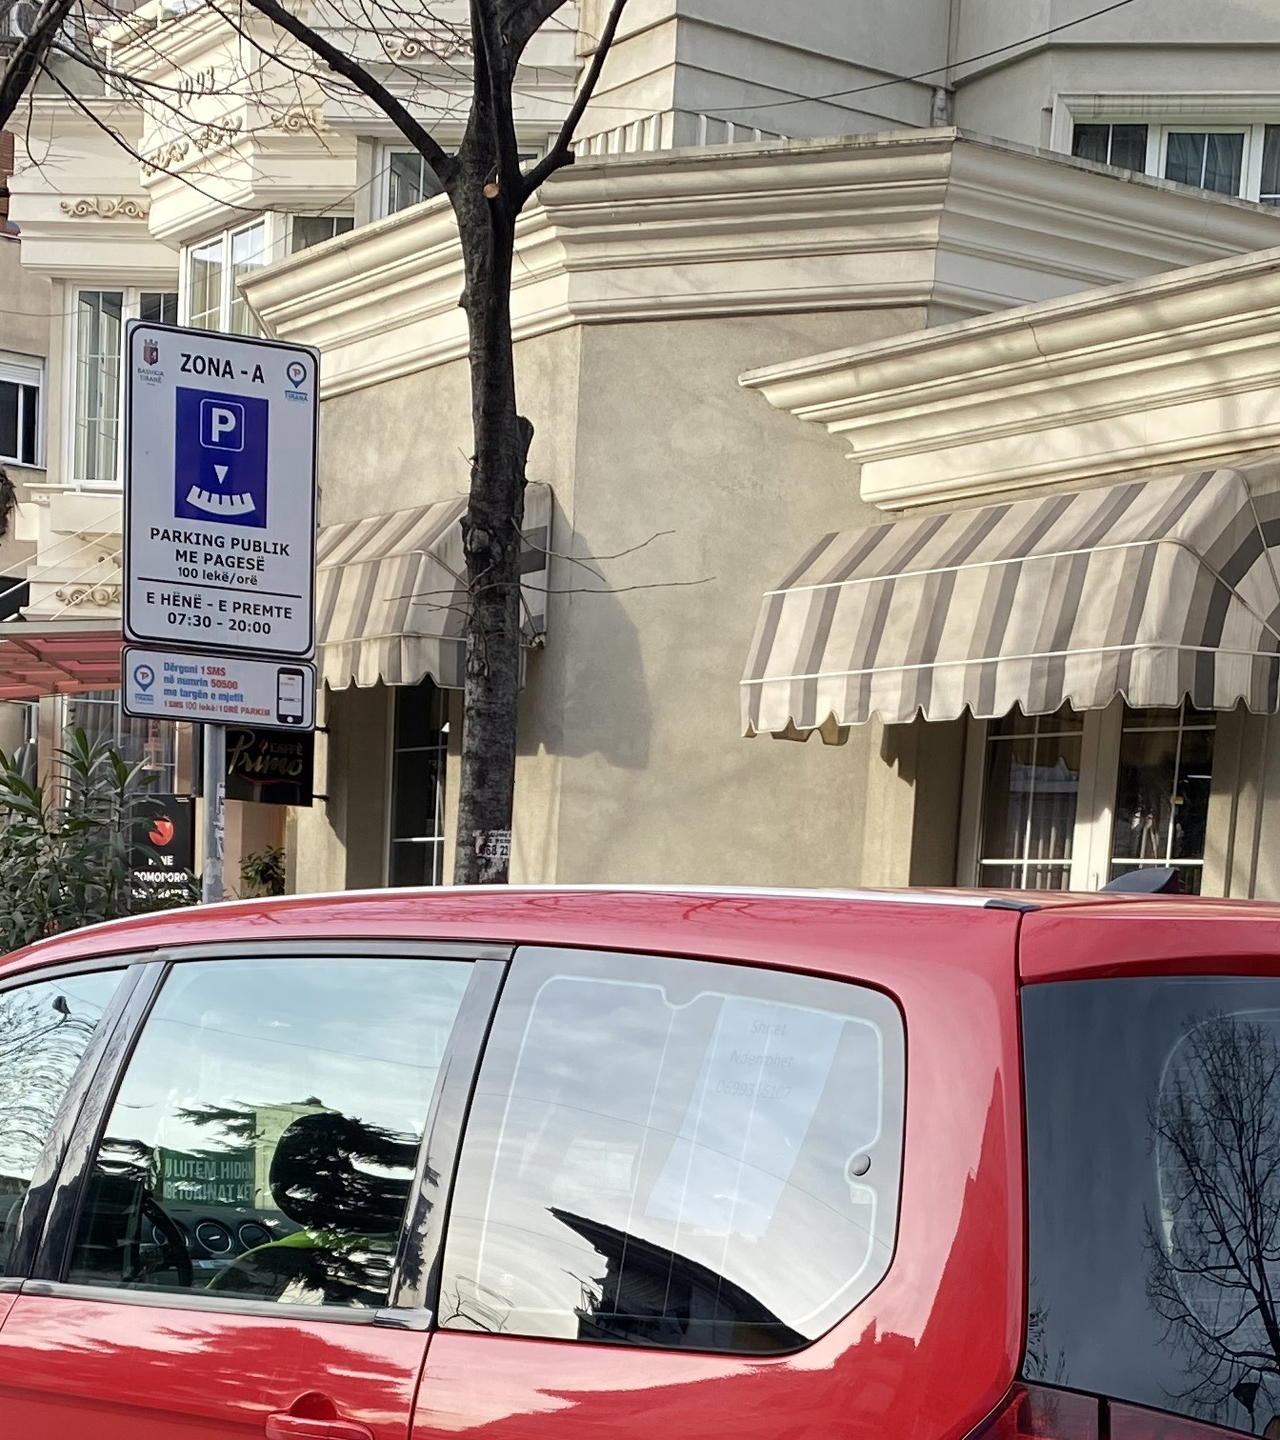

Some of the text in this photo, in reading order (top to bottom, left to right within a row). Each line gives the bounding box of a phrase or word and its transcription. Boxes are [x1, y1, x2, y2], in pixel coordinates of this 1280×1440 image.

[180, 352, 235, 380] ZONA
[251, 363, 265, 383] A
[211, 407, 236, 443] P
[150, 527, 290, 556] PARKING PUBLIK
[175, 549, 265, 572] ME PAGESË
[178, 566, 198, 578] 100
[146, 592, 155, 604] E
[161, 591, 202, 609] HËNË
[218, 600, 227, 612] E
[233, 601, 293, 619] PREMTE
[167, 612, 212, 628] 07:30
[228, 618, 272, 635] 20:00
[163, 662, 198, 675] Dërgoni
[206, 666, 226, 676] SMS
[163, 675, 238, 690] në numrin 50500
[174, 1159, 216, 1179] LUTEM
